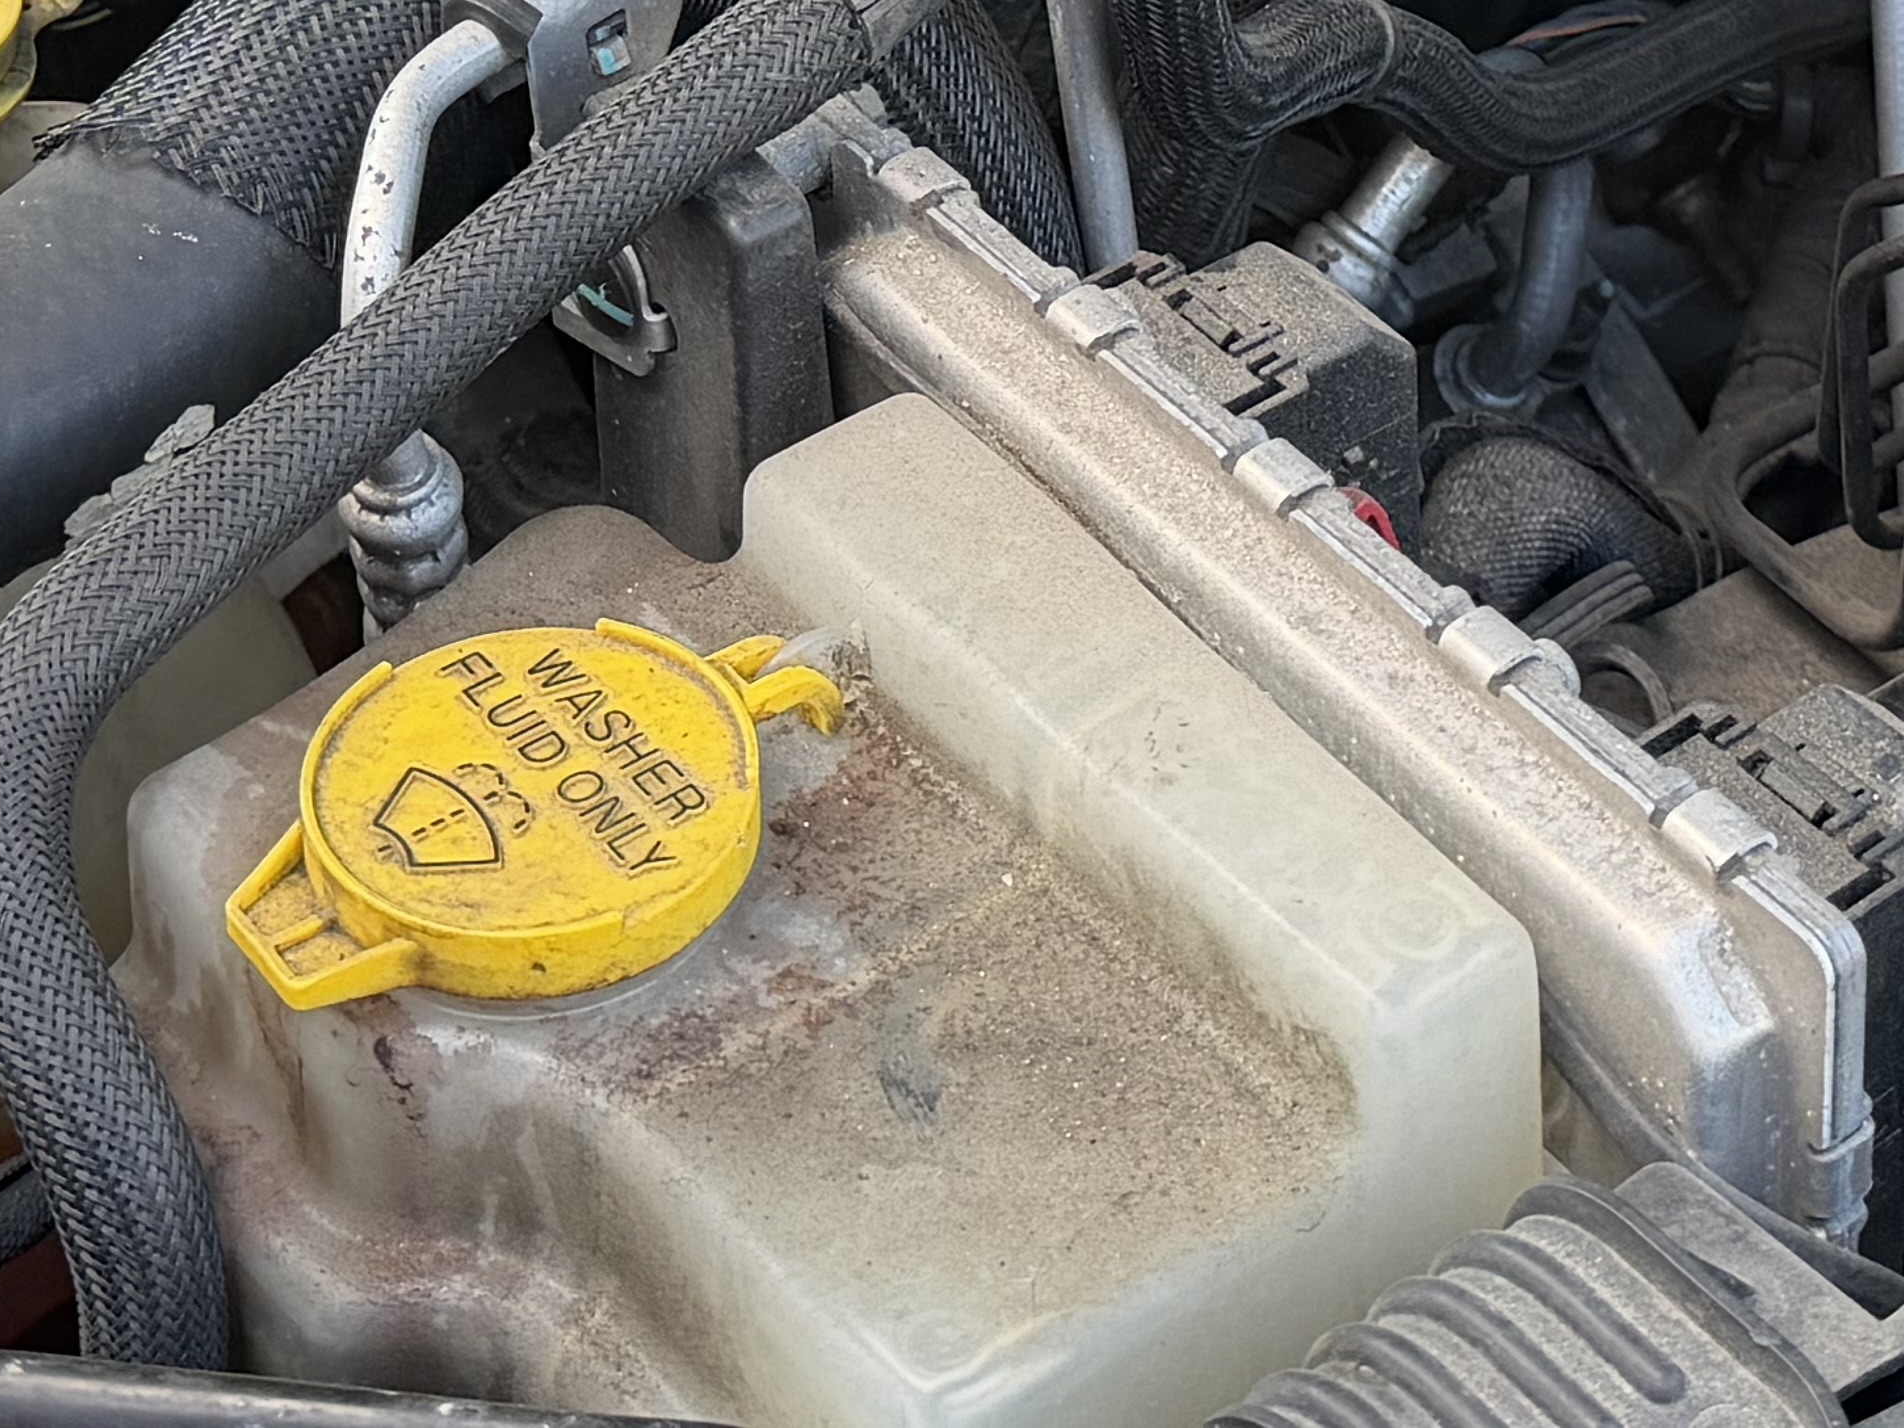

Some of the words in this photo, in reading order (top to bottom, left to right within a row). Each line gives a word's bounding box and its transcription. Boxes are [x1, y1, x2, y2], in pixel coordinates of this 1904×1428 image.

[439, 650, 571, 769] FLUID
[556, 768, 680, 876] ONLY
[527, 646, 709, 827] WASHER
